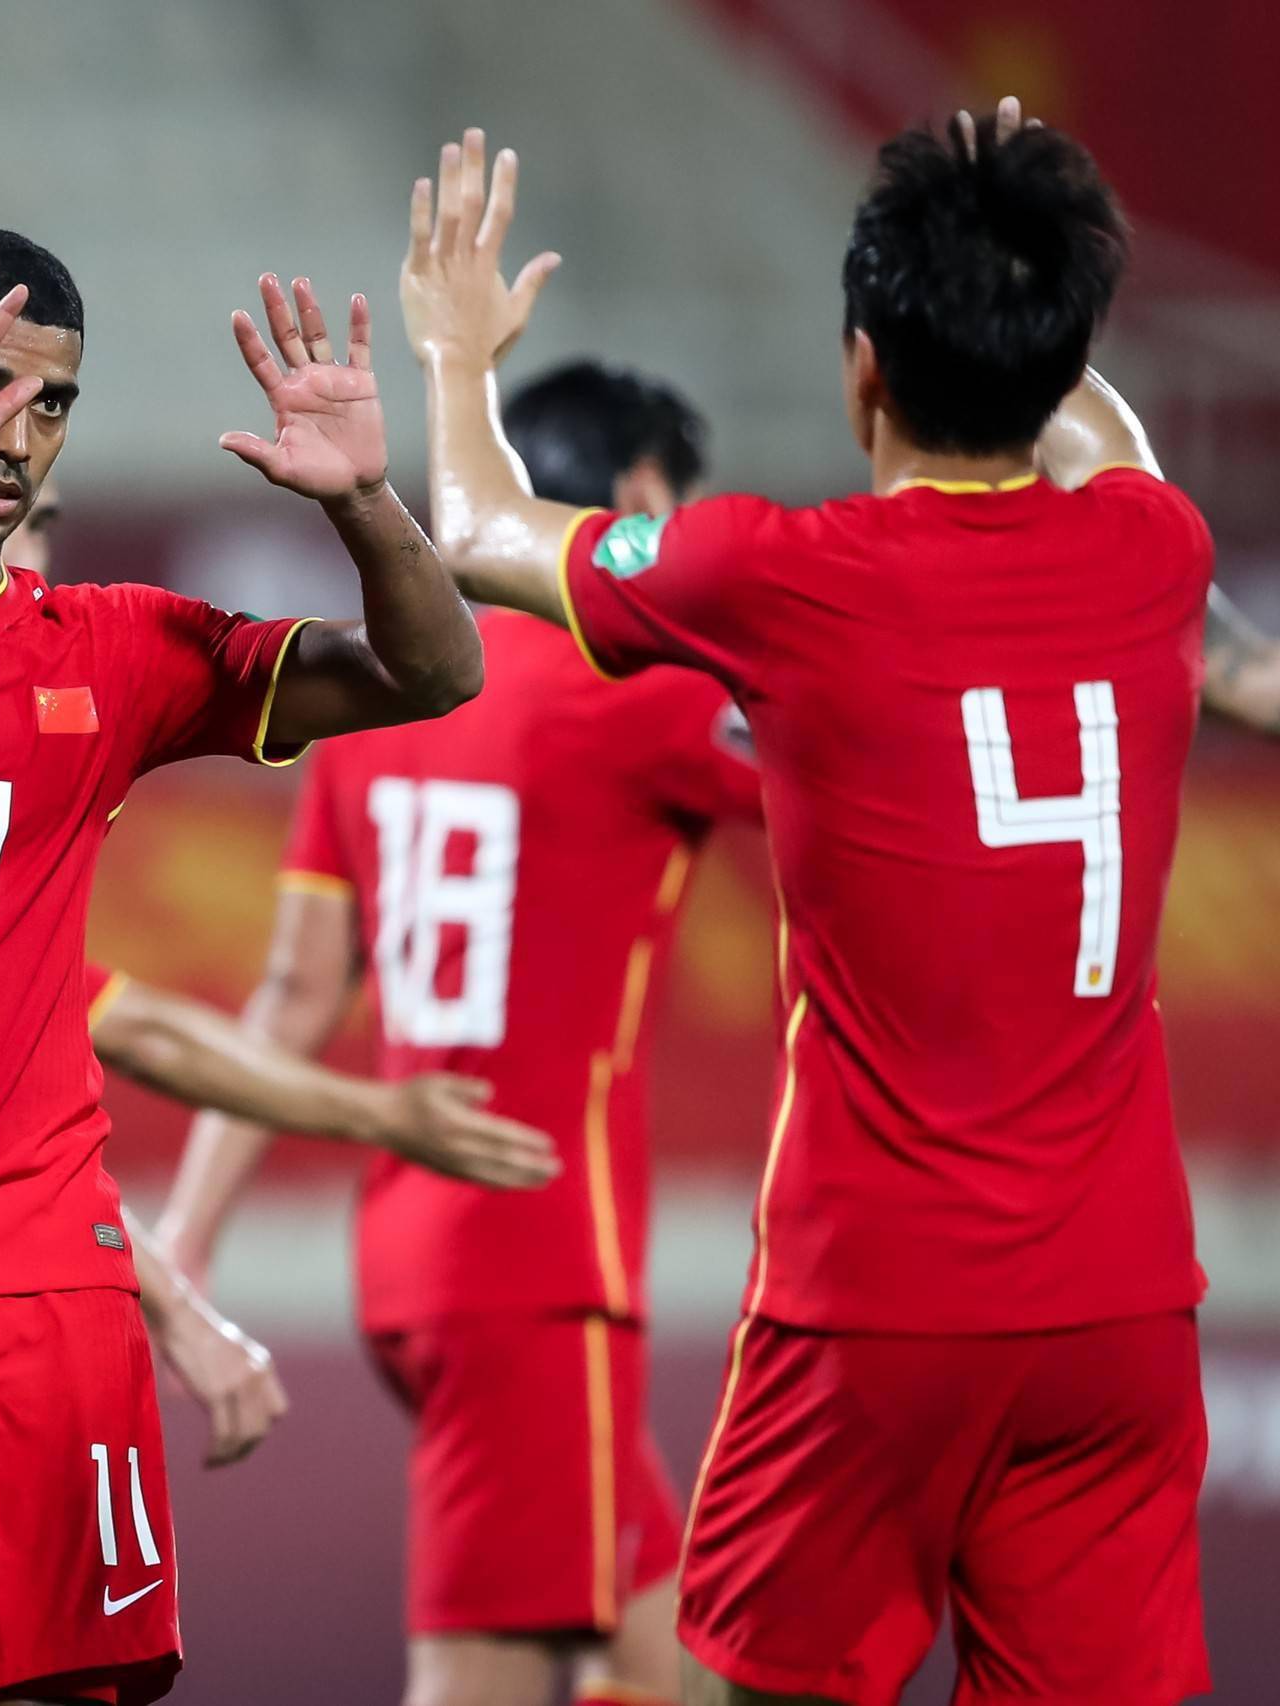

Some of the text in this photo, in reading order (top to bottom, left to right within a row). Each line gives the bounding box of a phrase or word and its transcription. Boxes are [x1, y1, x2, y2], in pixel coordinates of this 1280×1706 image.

[368, 776, 519, 1048] 18
[961, 680, 1122, 997] 4
[91, 1443, 161, 1566] 11
